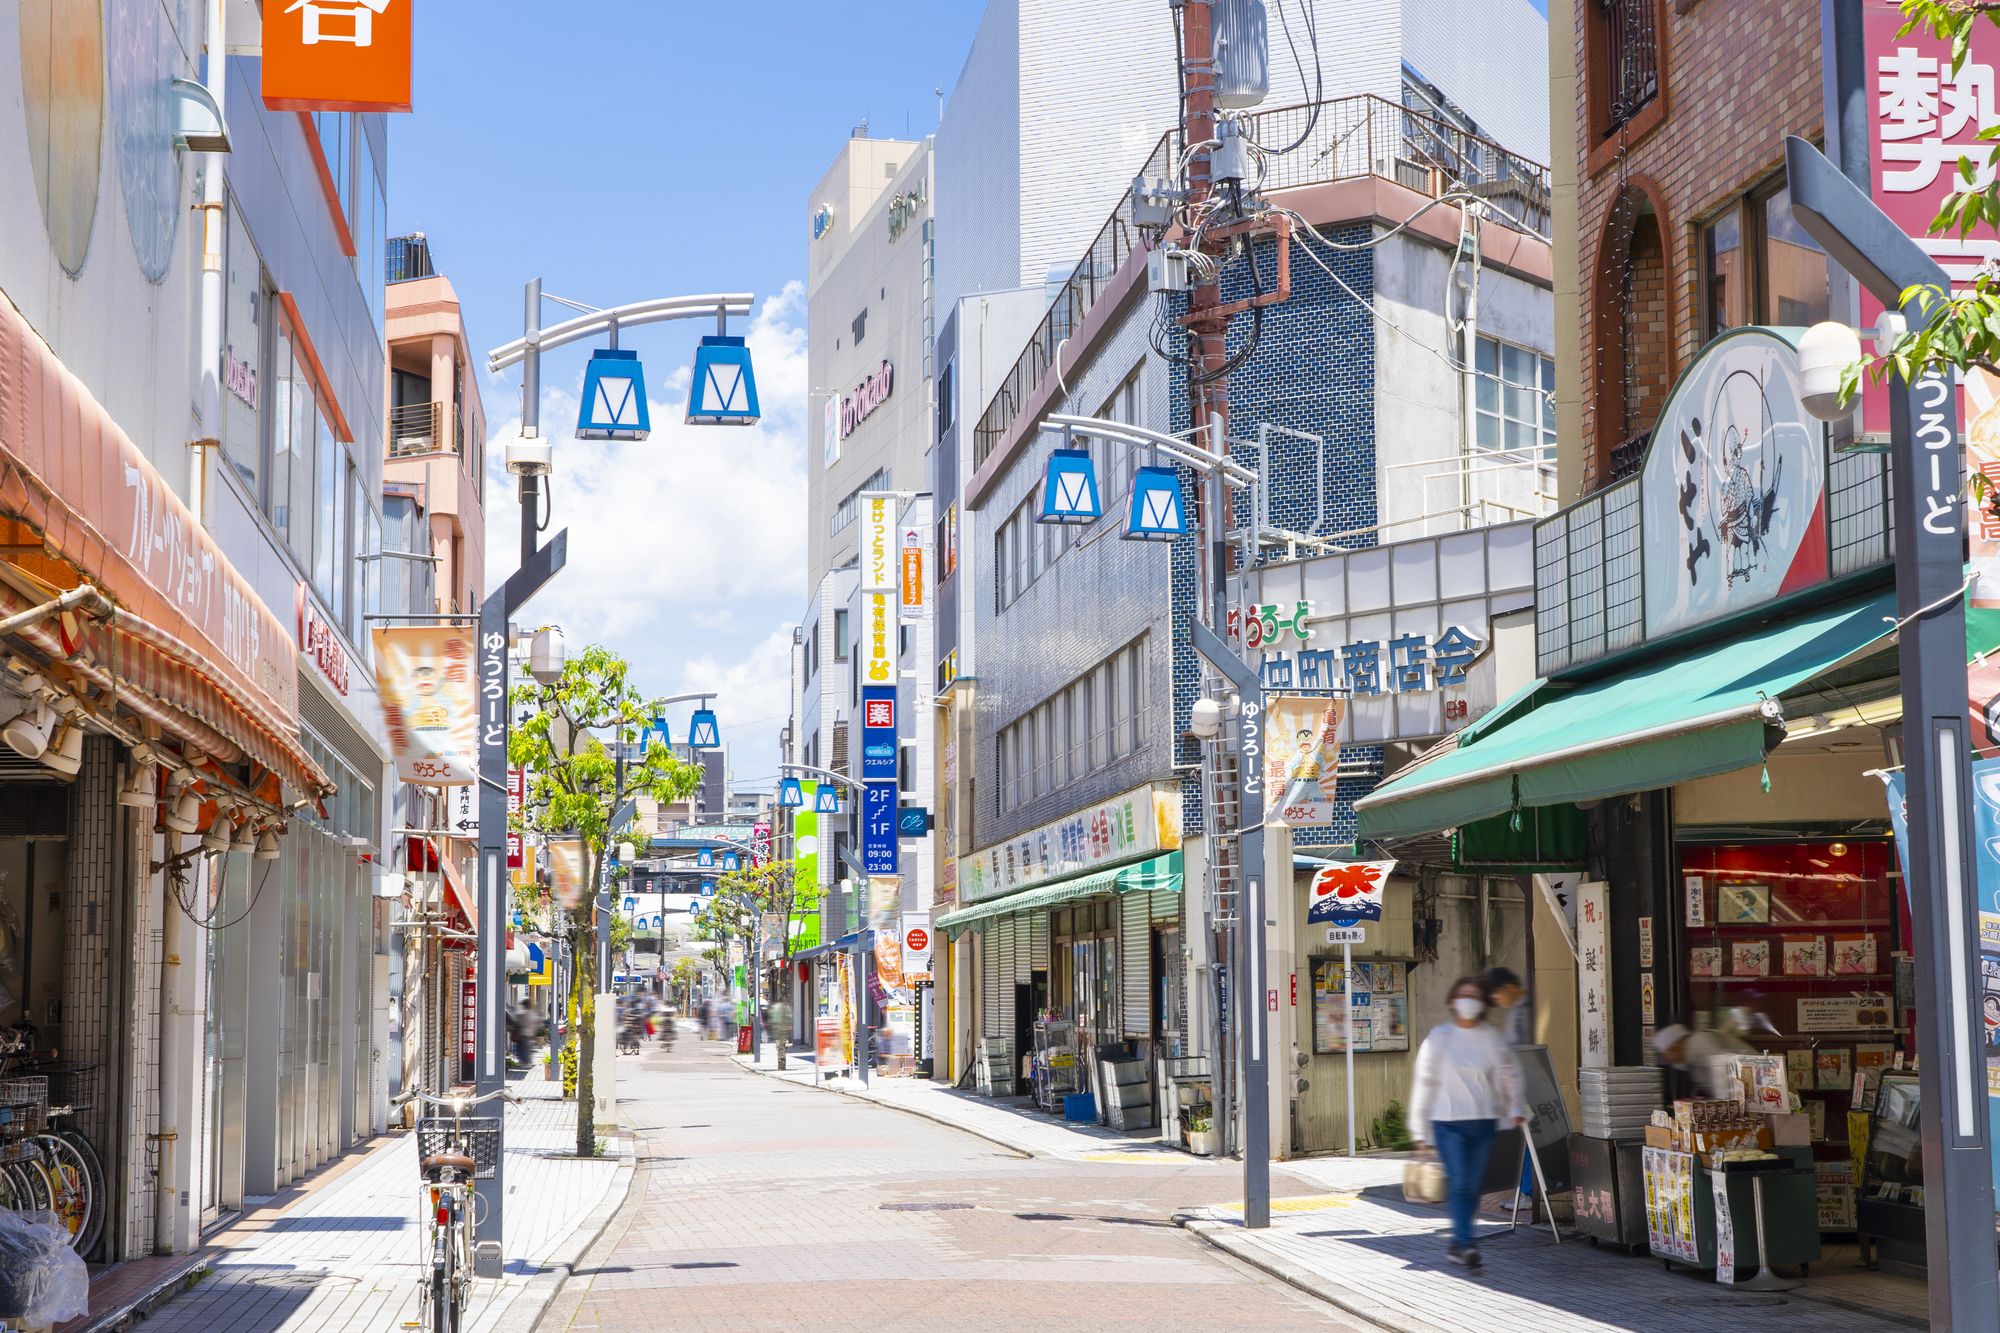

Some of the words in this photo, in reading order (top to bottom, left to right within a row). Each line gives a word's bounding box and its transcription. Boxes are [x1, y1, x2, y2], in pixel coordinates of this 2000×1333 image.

[852, 359, 893, 429] Yokado
[1913, 360, 1958, 535] うろーど
[908, 555, 917, 605] 不動産ショップ
[872, 592, 886, 659] 亀有保育園
[1258, 625, 1482, 711] 仲町商店会
[483, 632, 505, 746] ゆうろーど
[869, 703, 890, 725] 薬
[1321, 708, 1338, 745] 亀有
[1241, 701, 1260, 794] ゆうろーど
[413, 762, 452, 778] ゆうろーど
[1269, 761, 1286, 798] 最高
[870, 790, 891, 802] 2F
[1284, 806, 1316, 819] ゆうろーど
[683, 826, 755, 835] リフォーム・リノベーシ
[870, 823, 890, 835] 1F
[868, 850, 892, 858] 09:00
[868, 863, 892, 871] 23:00
[859, 879, 867, 917] ゆうろーど
[1329, 930, 1362, 941] 自転車を除く
[463, 995, 474, 1053] 亀有接骨院
[1575, 1186, 1614, 1224] 豆大福
